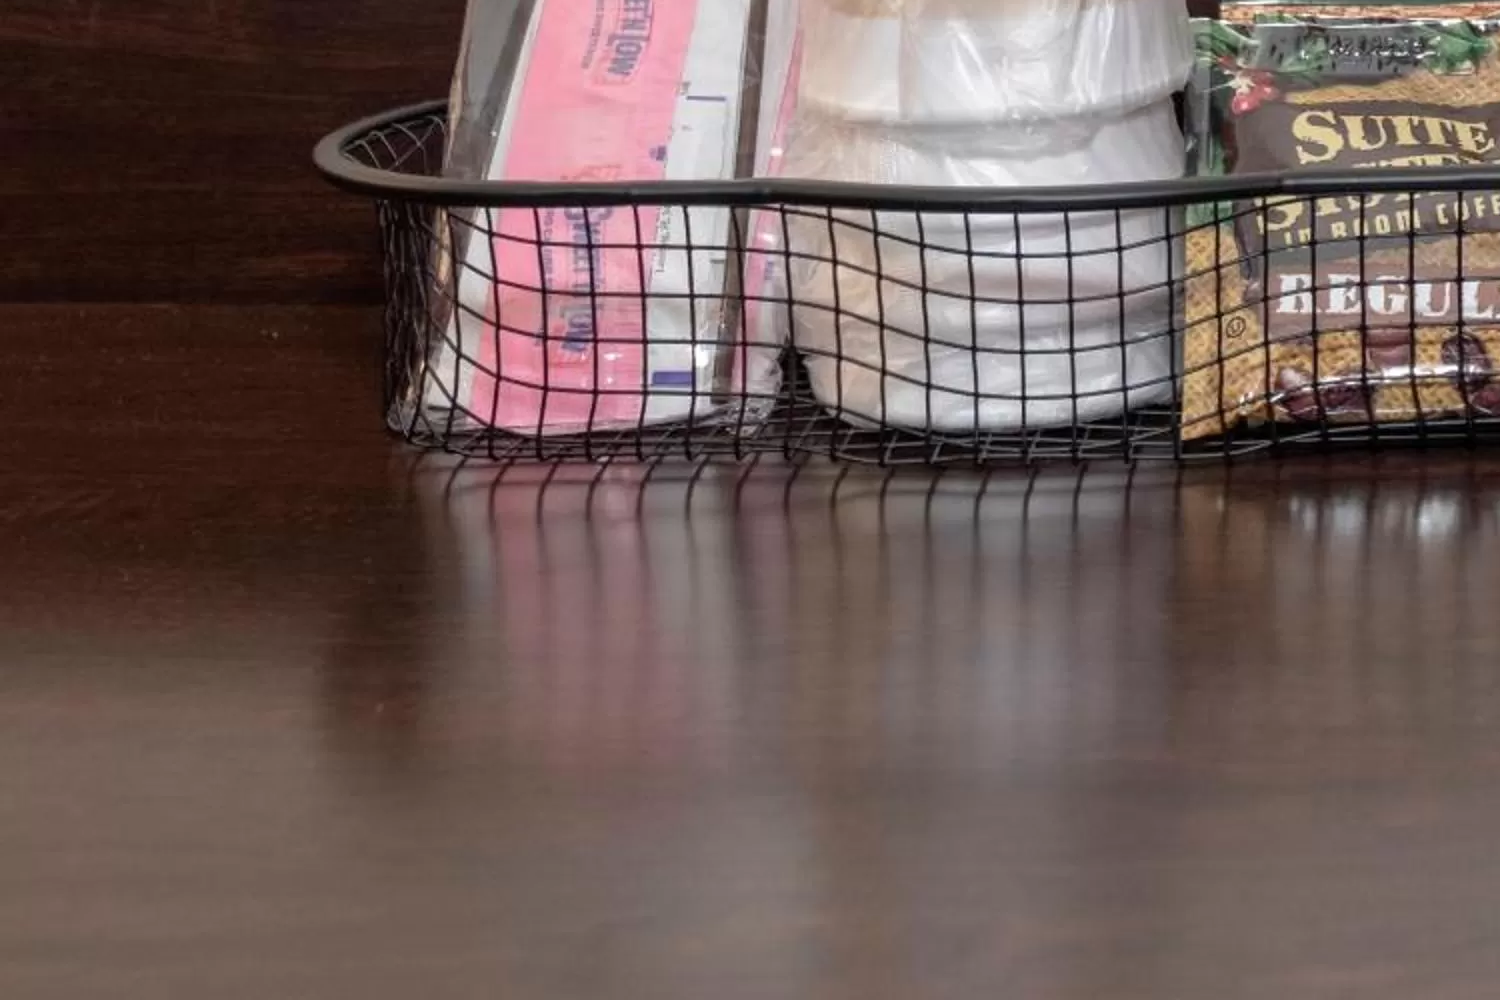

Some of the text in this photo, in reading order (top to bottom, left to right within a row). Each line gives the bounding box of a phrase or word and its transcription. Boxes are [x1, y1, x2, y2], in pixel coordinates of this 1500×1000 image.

[606, 33, 651, 76] LOW
[1291, 109, 1495, 165] SUITE
[1330, 210, 1421, 240] ROOM
